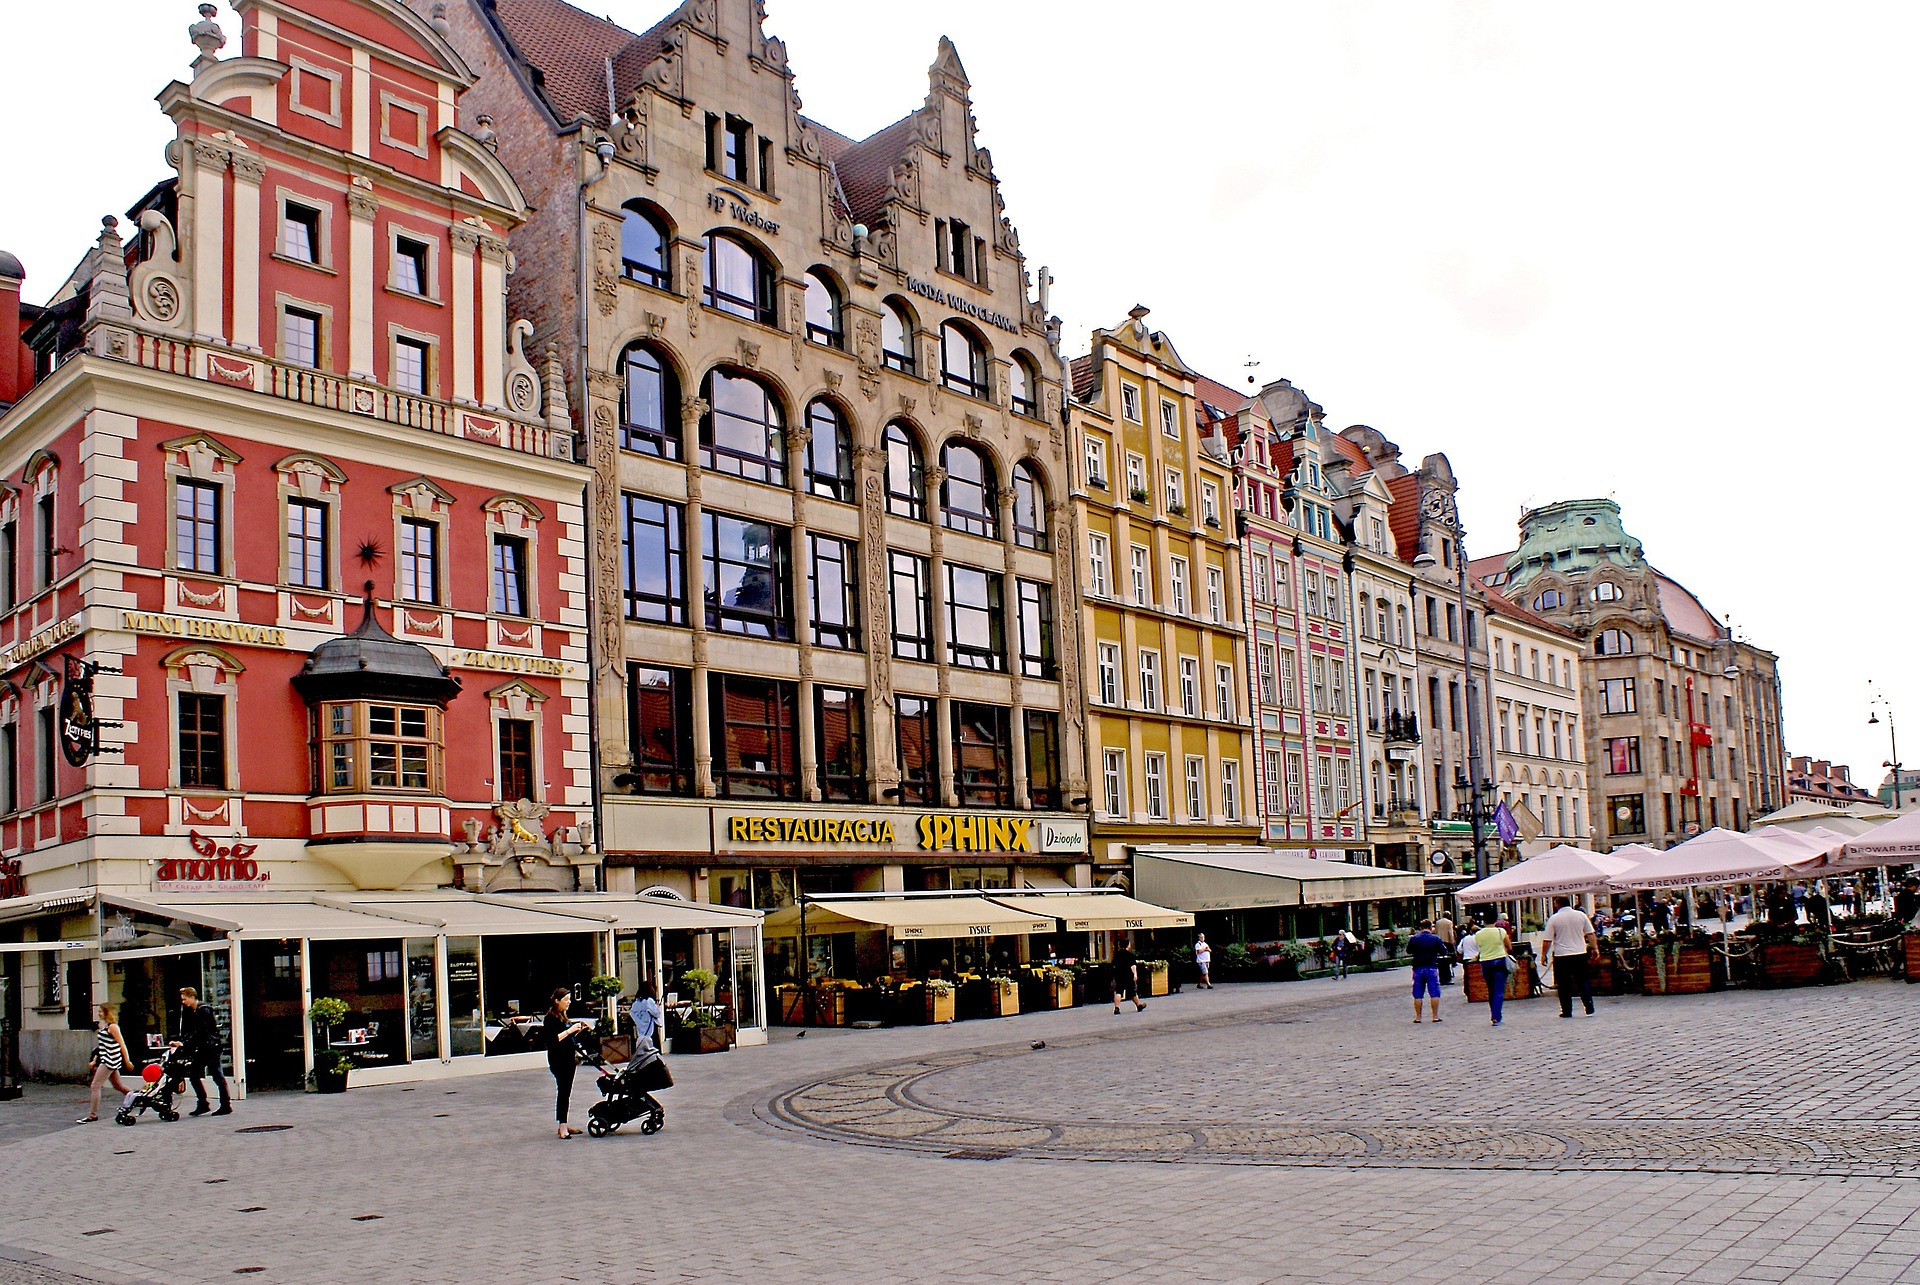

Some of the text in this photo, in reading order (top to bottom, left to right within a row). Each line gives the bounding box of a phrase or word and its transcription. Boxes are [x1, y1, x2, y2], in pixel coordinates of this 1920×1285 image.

[730, 202, 780, 235] Weber
[906, 276, 946, 305] MODA
[947, 293, 1009, 331] WROCŁAW
[123, 612, 286, 646] MINI BROWAR
[525, 658, 565, 675] PIES
[728, 814, 1032, 852] RESTAURACJA SPHINX
[1610, 868, 1781, 892] CRAFT BREWERY GOLDEN DOG
[968, 925, 991, 935] TYSKIE
